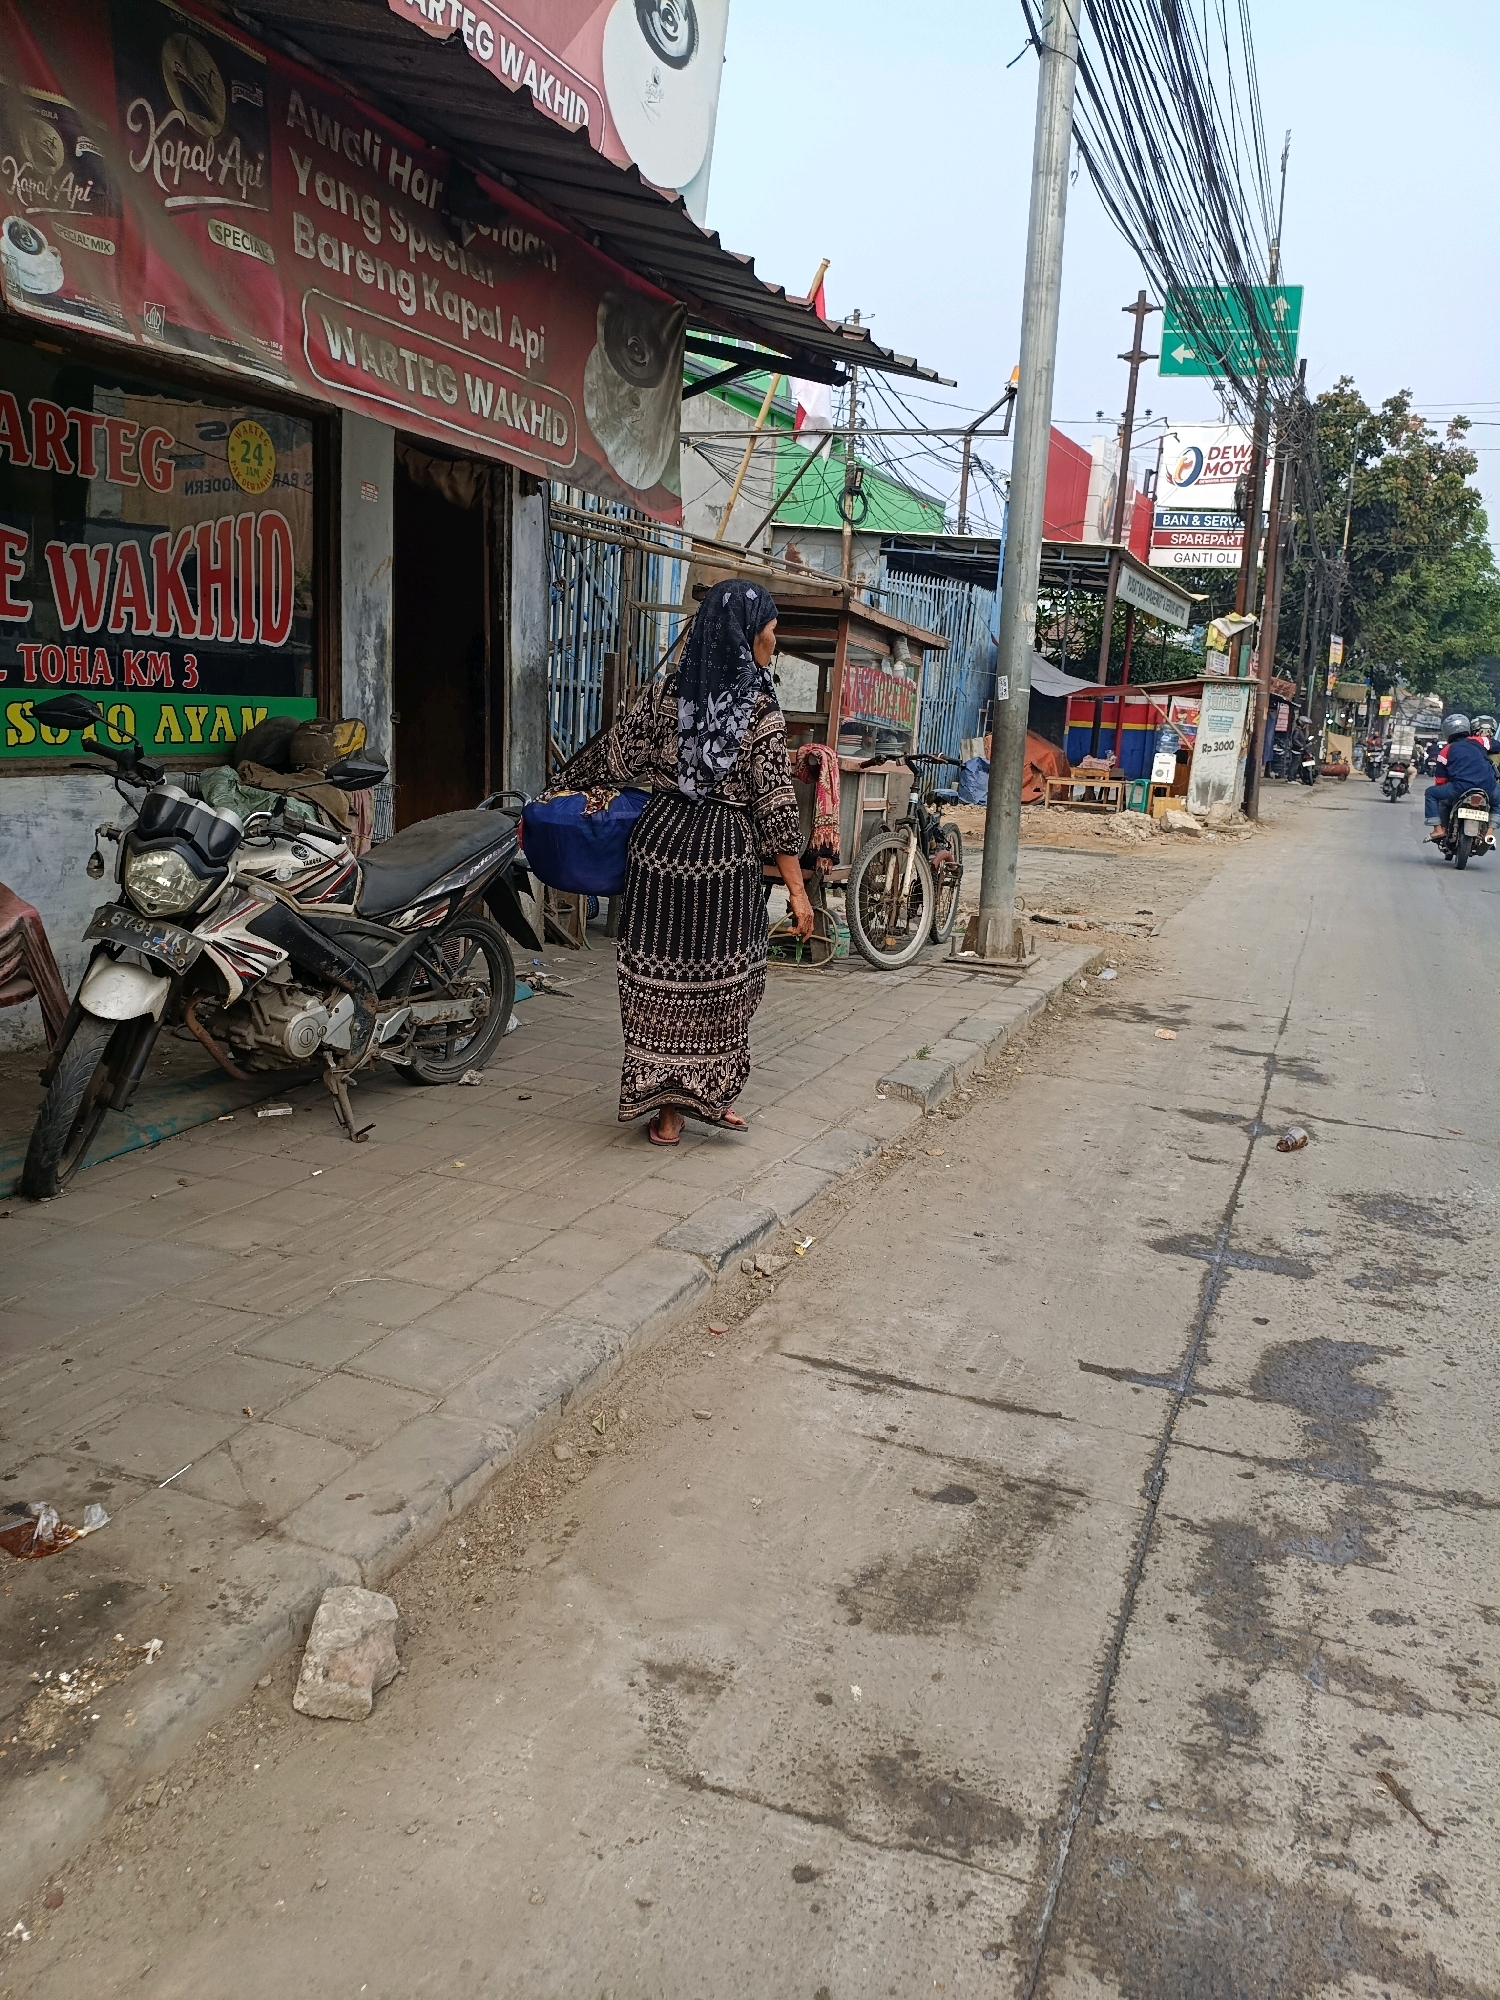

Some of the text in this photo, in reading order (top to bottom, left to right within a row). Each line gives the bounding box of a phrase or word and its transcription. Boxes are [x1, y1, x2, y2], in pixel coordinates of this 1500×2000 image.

[499, 34, 590, 126] WAKHID
[126, 97, 266, 200] Kapal Api
[286, 87, 383, 172] Awali
[1, 155, 94, 210] Kapal Api
[287, 146, 382, 246] Yang
[91, 238, 112, 253] MIX
[213, 222, 270, 260] SPECIAL
[292, 211, 546, 368] Bareng Kapal Api
[320, 312, 569, 448] WARTEG WAKHID
[233, 423, 271, 447] WARTEG
[240, 439, 264, 467] 24
[231, 459, 243, 479] PAK
[245, 466, 260, 478] JAM
[1162, 514, 1190, 526] BAN
[1191, 514, 1201, 526] &
[1170, 533, 1245, 546] SPAREPART
[1173, 552, 1237, 564] GANTI OLI
[44, 508, 295, 648] WAKHID
[16, 642, 200, 689] TOHA KM 3
[1201, 739, 1235, 755] Rp 3000
